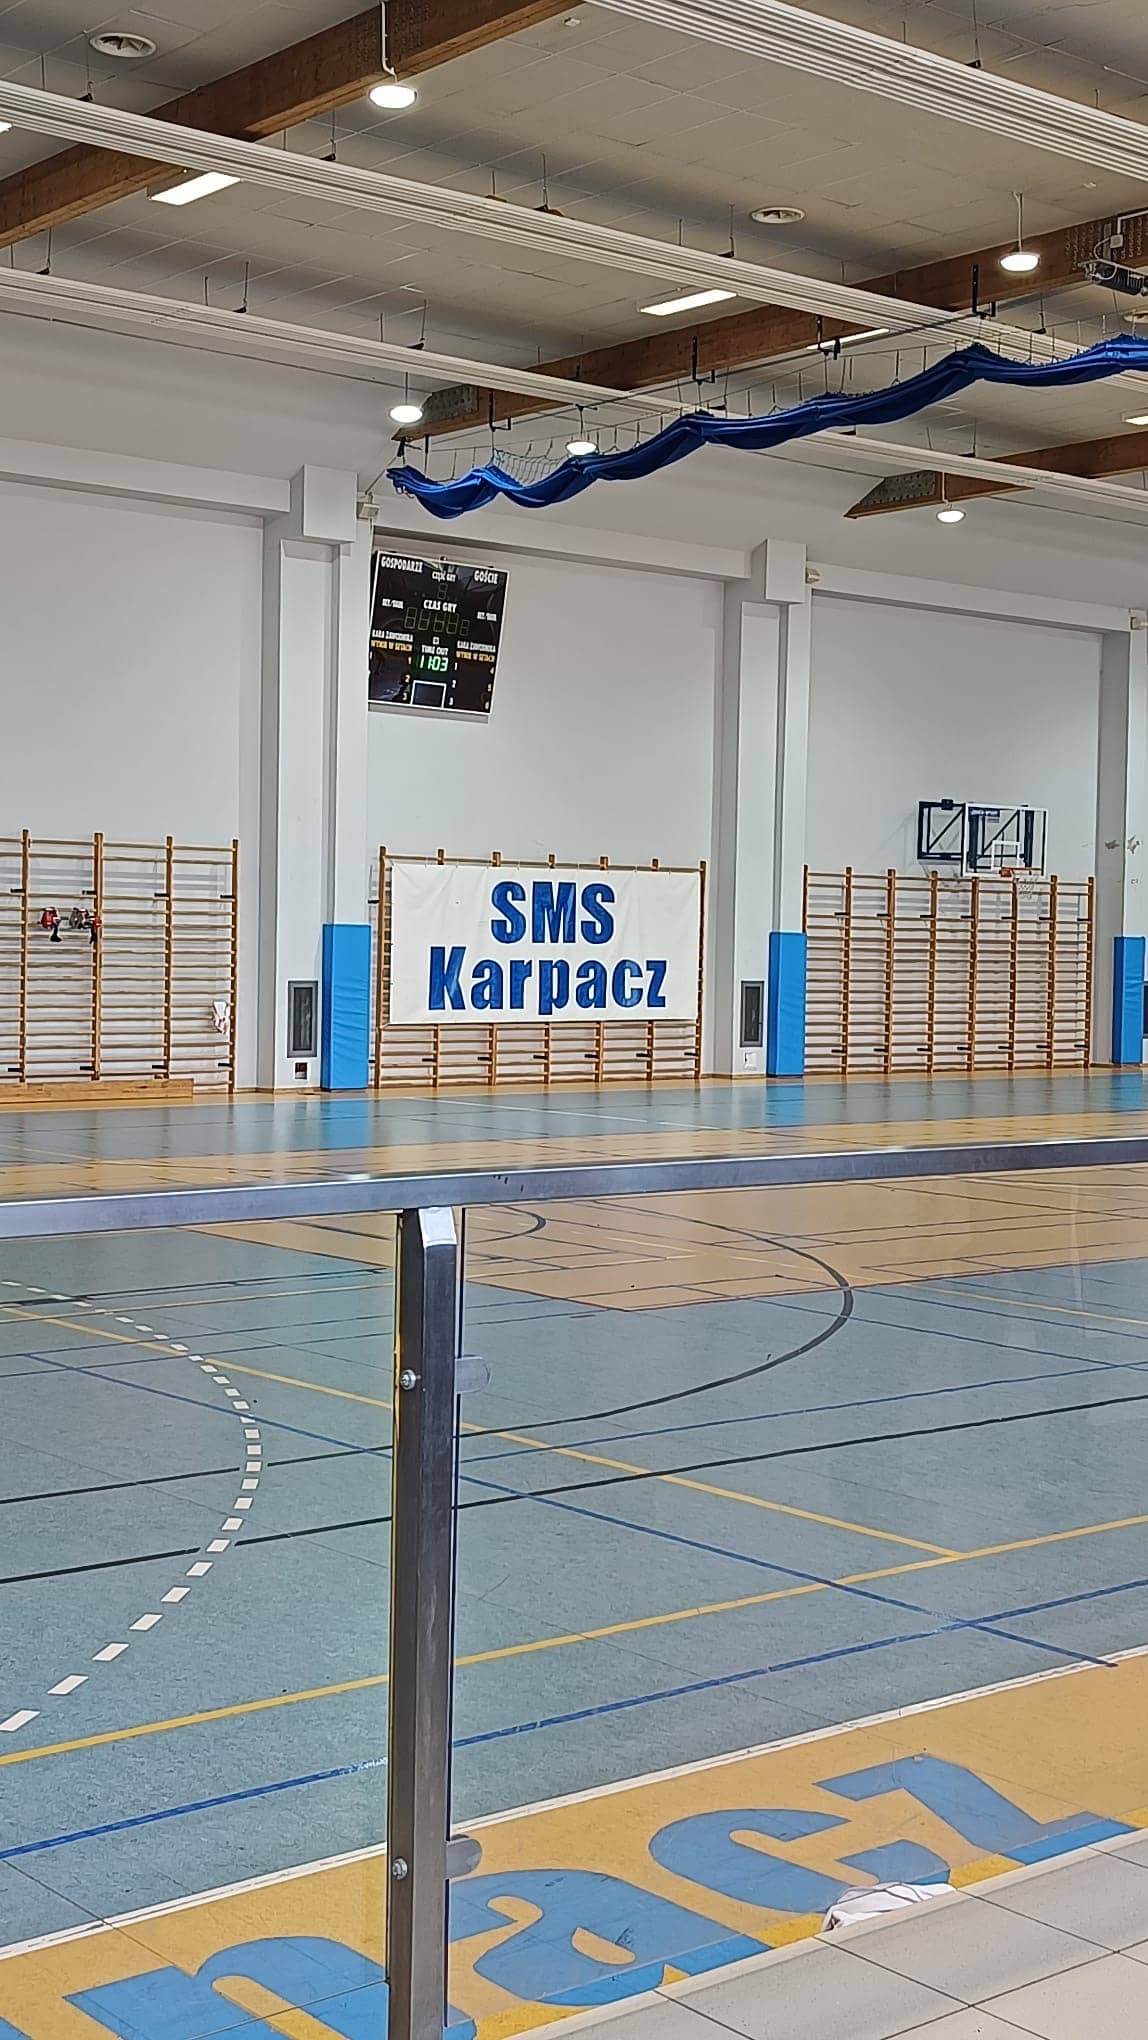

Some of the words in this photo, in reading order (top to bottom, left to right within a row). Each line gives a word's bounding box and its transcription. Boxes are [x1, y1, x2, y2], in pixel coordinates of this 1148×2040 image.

[381, 556, 423, 573] GOSPODARZE
[474, 569, 499, 584] GOŚCIE
[423, 599, 441, 610] CZAS
[442, 602, 457, 613] GRY
[436, 646, 449, 656] OUT
[419, 655, 449, 672] 11:03
[491, 881, 616, 944] SMS
[428, 946, 668, 1016] Karpacz
